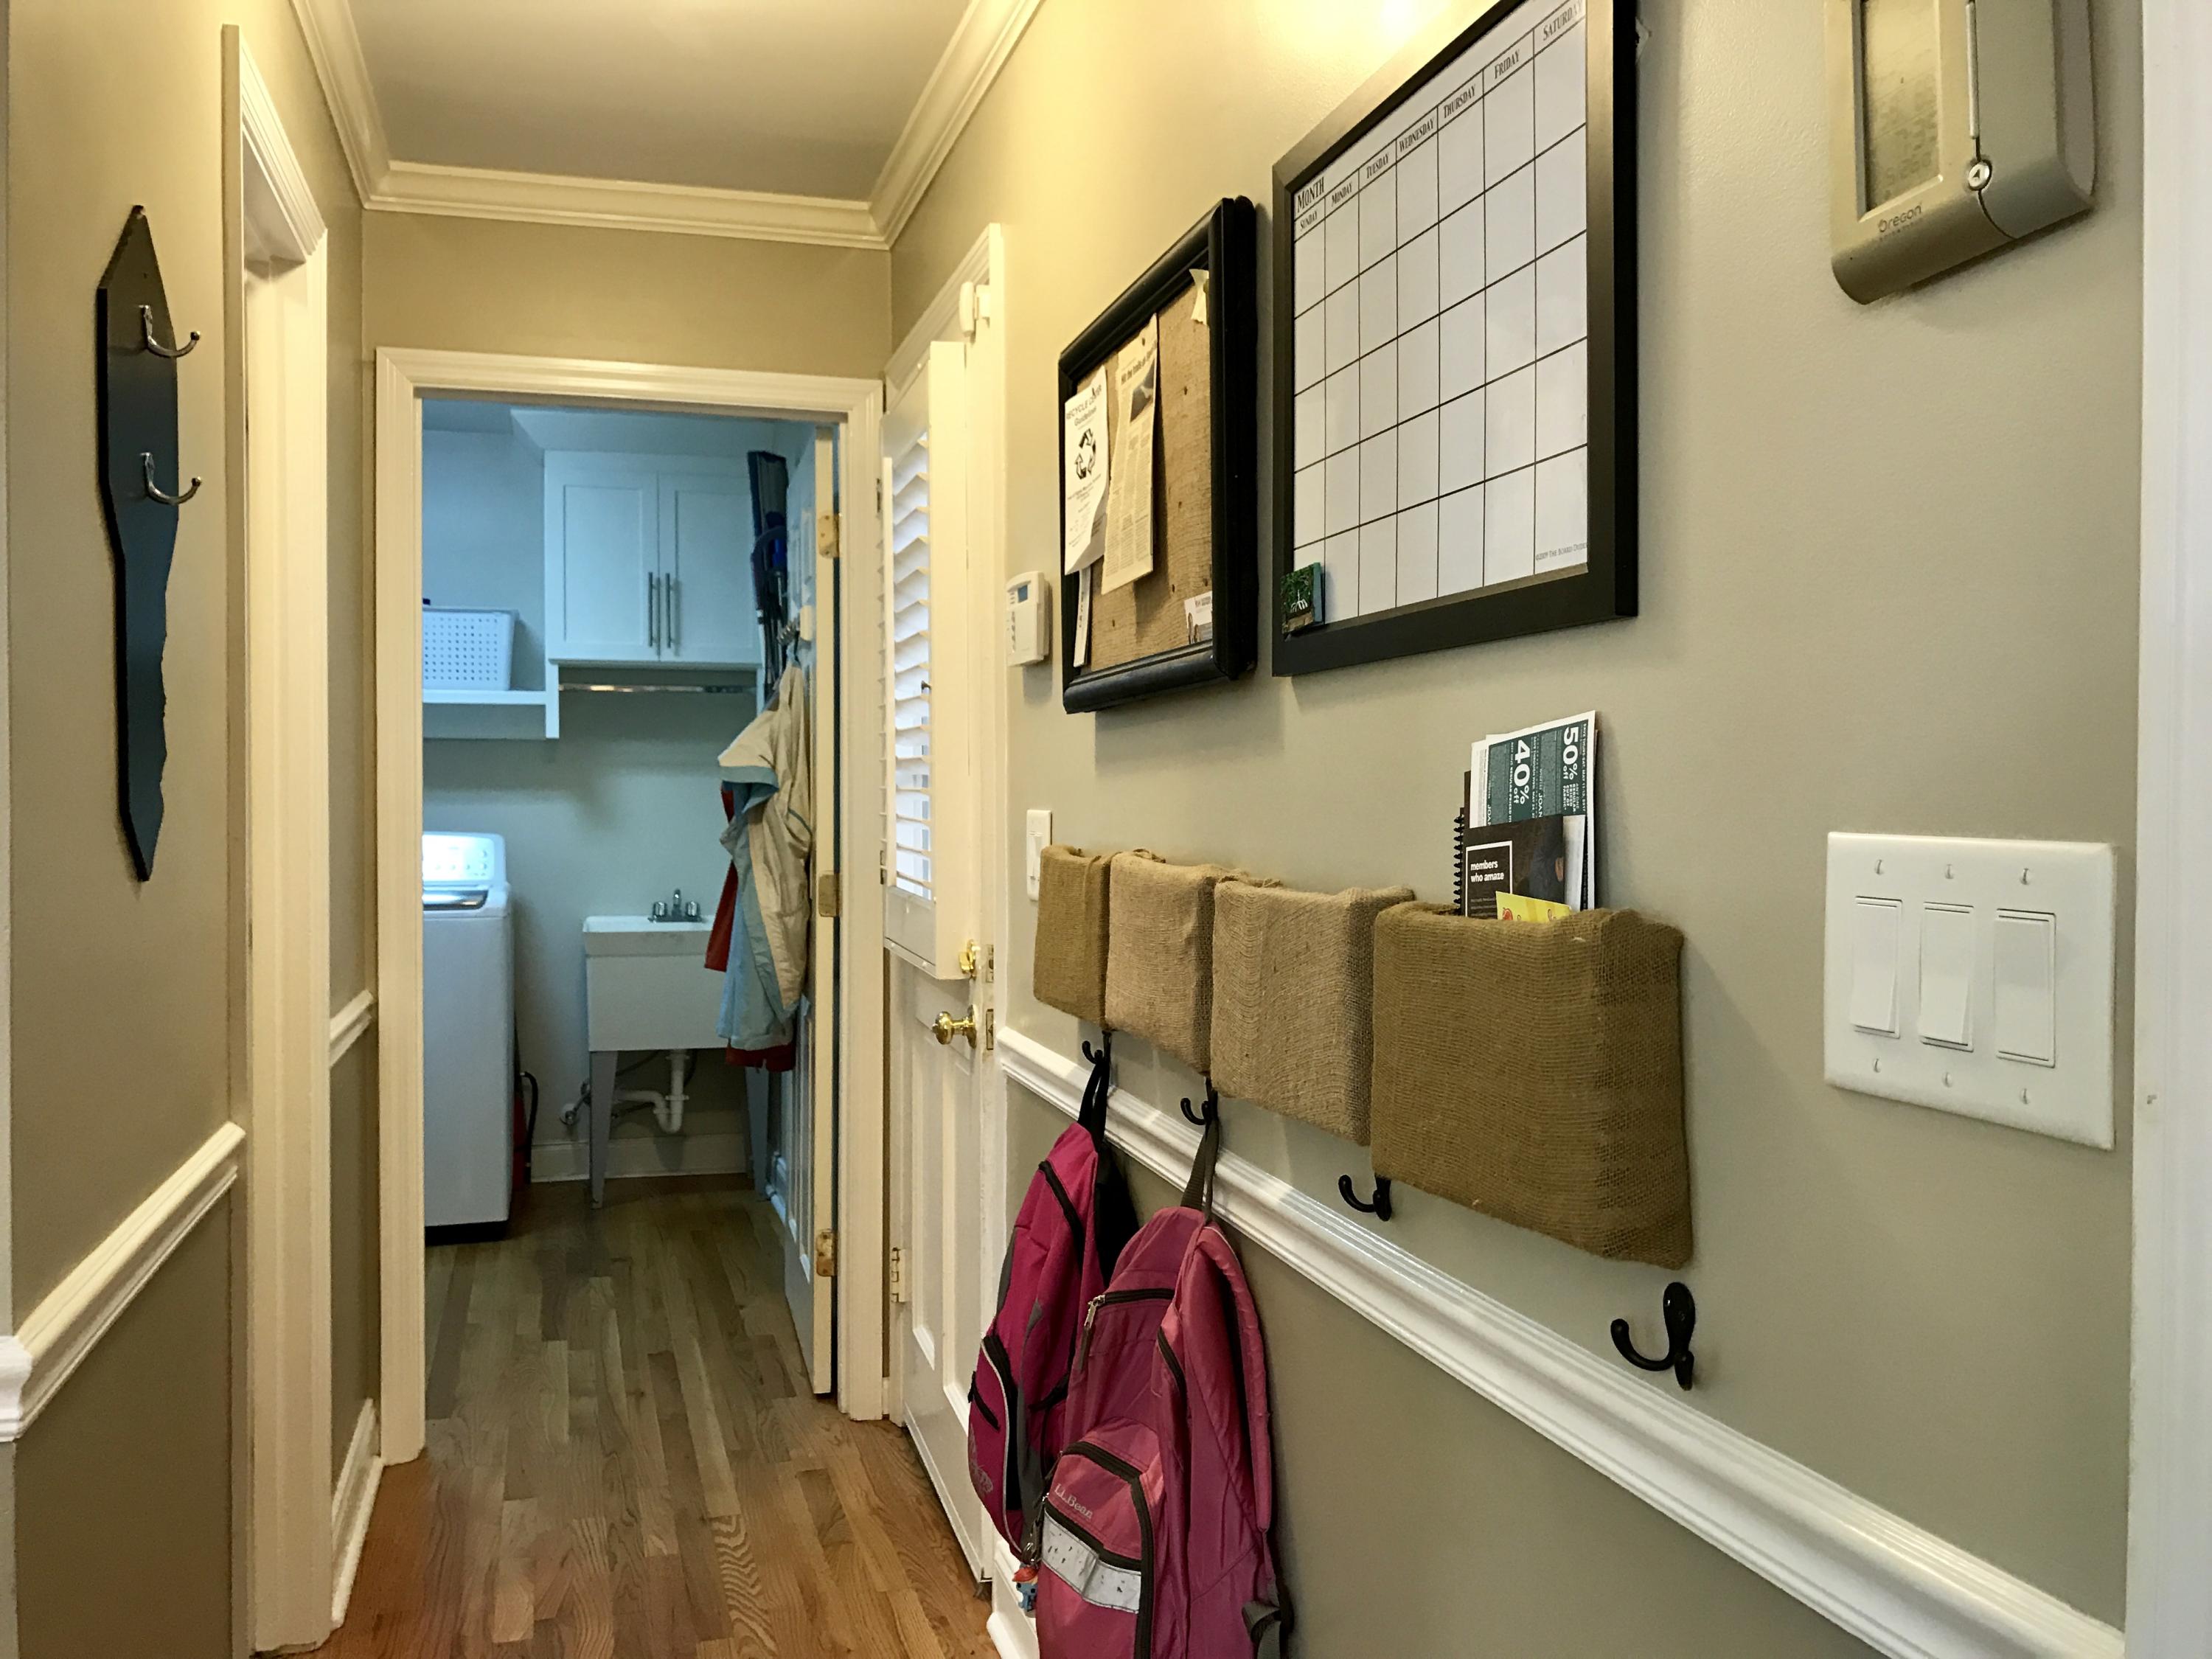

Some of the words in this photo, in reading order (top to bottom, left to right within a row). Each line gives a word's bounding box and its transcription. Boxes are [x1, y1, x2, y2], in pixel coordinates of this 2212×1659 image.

[1300, 210, 1318, 232] SUNDAY
[1332, 181, 1353, 207] MONDAY
[1366, 153, 1389, 179] TUESDAY
[1399, 117, 1435, 153] WEDNESDAY
[1443, 84, 1475, 119] THURSDAY
[1494, 49, 1520, 80] FRIDAY
[1543, 0, 1584, 41] SATURDAY
[1297, 176, 1324, 213] MONTH
[1514, 740, 1530, 804] 40%
[1562, 726, 1579, 780] 50%
[1470, 860, 1498, 871] members
[1470, 872, 1484, 883] who
[1484, 872, 1505, 881] amaze
